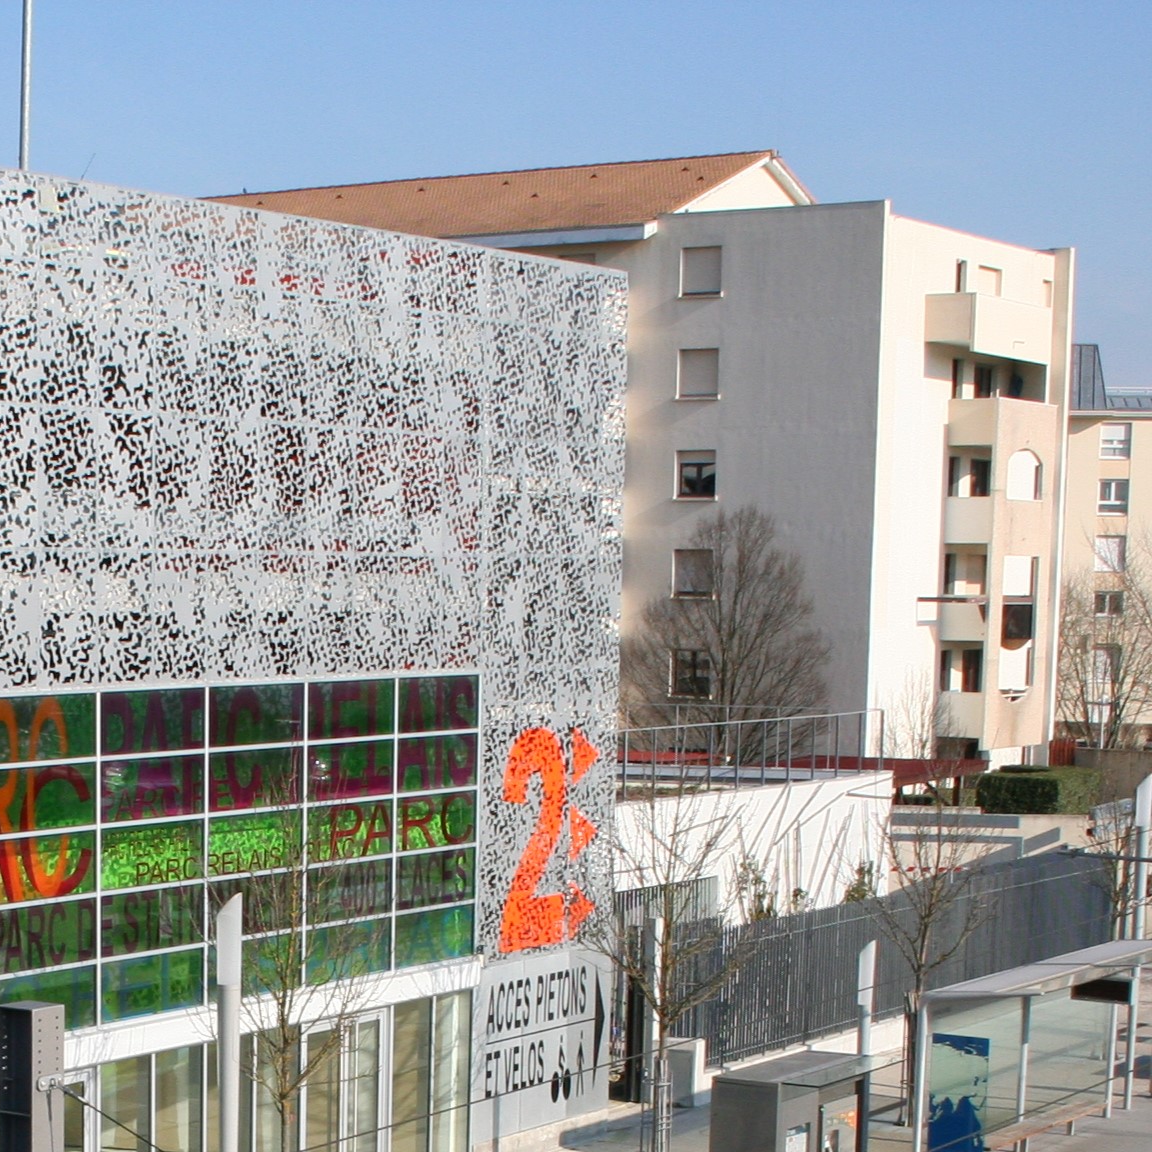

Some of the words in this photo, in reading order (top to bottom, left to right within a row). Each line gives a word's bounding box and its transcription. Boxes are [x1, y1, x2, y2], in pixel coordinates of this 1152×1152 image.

[329, 793, 473, 857] PARC
[498, 727, 566, 954] 2
[136, 856, 197, 885] PARC
[208, 847, 282, 875] RELAIS
[78, 894, 114, 963] DE
[486, 976, 531, 1035] ACCES
[535, 965, 587, 1024] PIETONS
[485, 1050, 500, 1099] ET
[503, 1039, 545, 1093] VELOS
